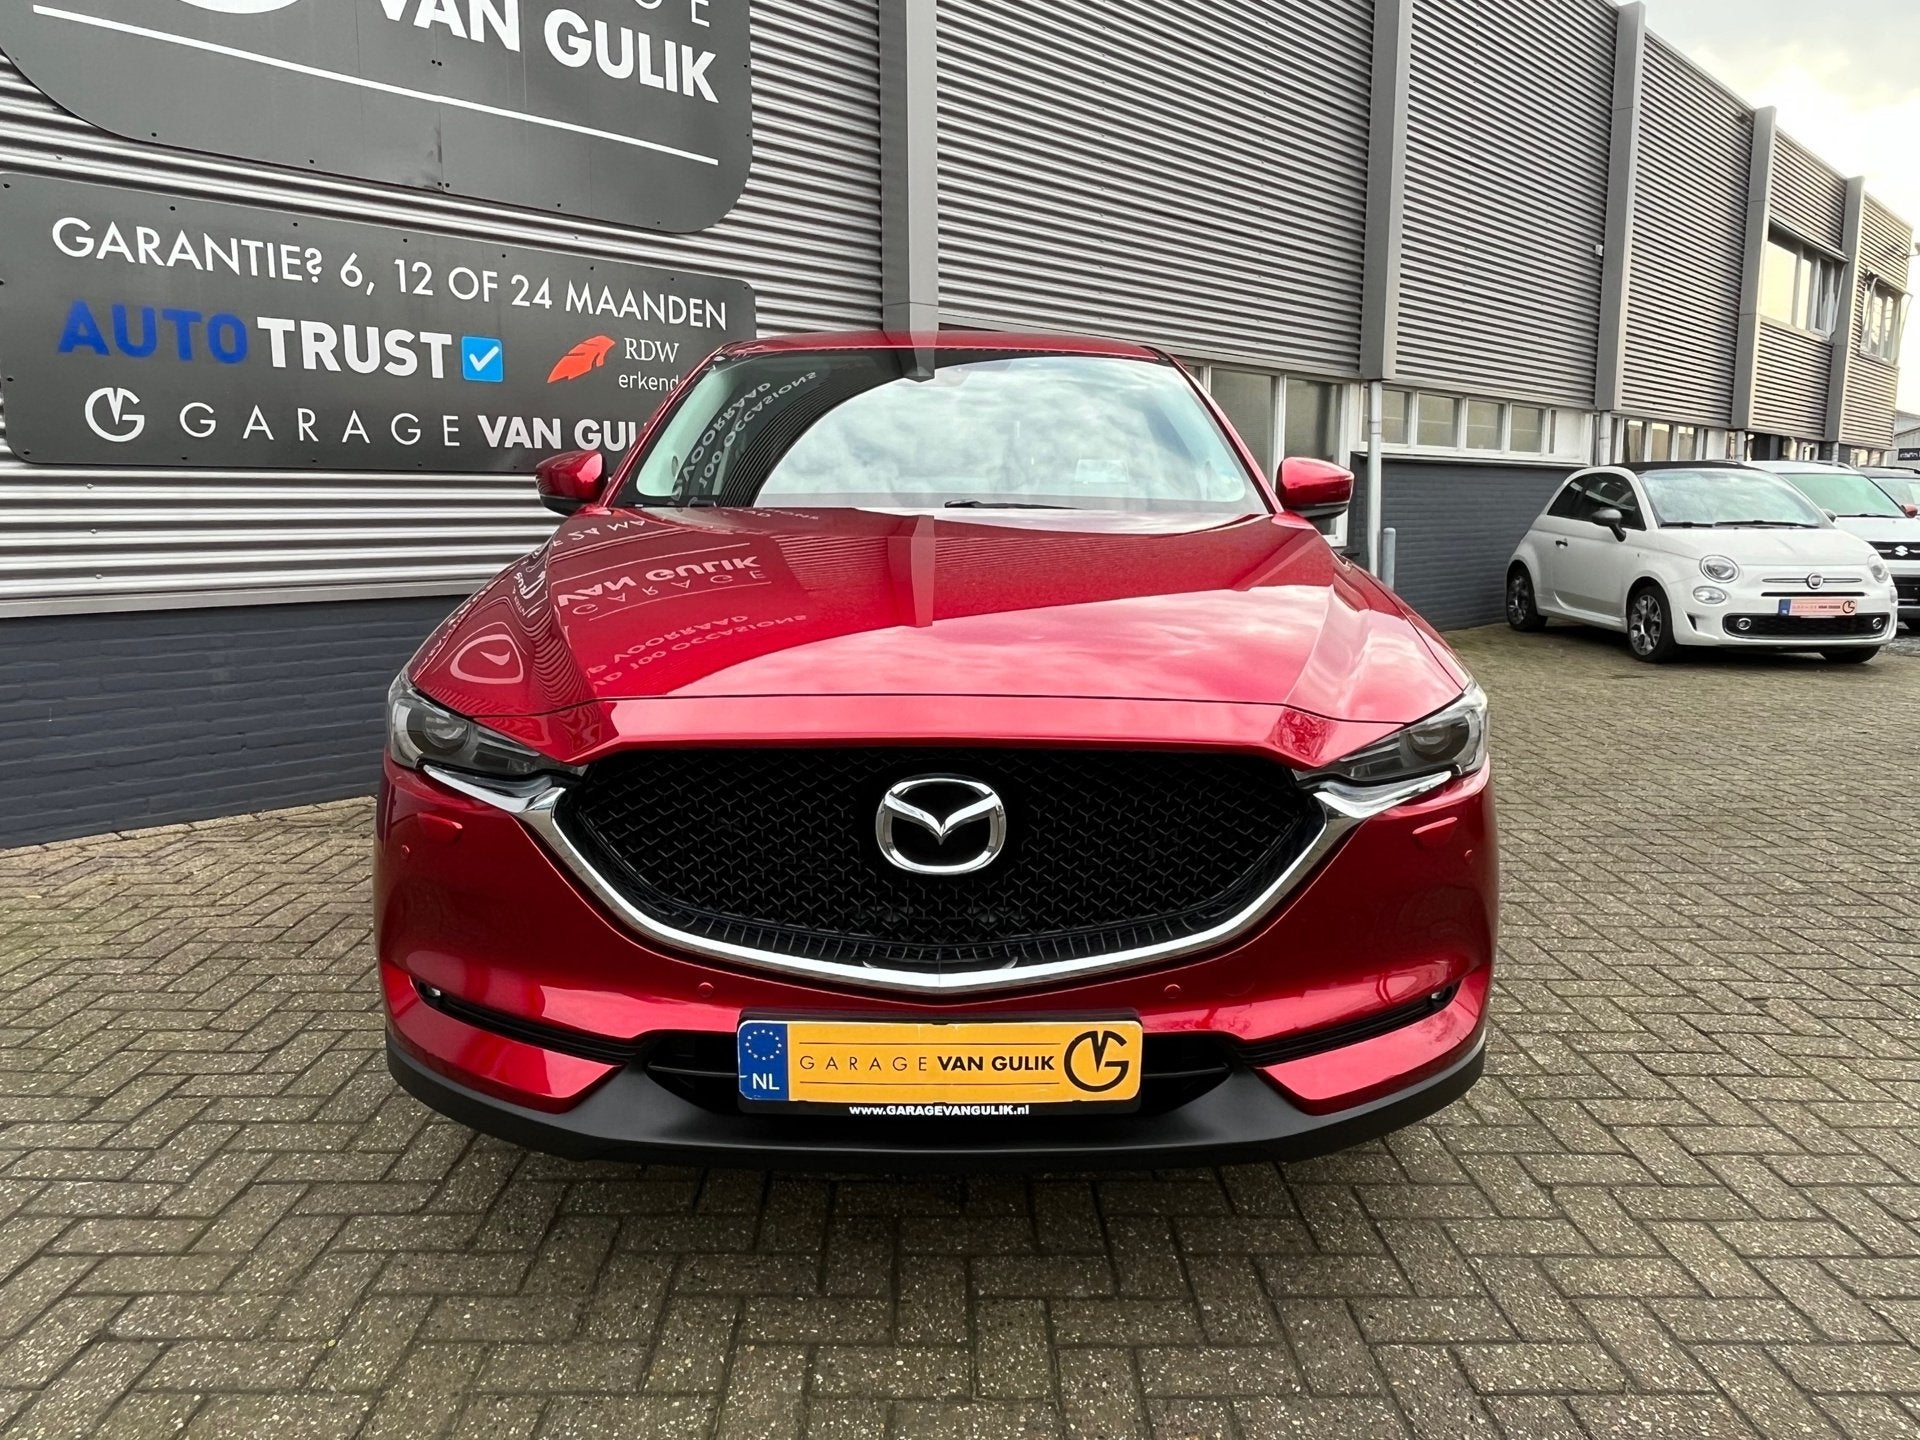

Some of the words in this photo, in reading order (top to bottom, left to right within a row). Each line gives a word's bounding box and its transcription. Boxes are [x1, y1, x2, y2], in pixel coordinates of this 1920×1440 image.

[544, 8, 719, 103] GULIK
[52, 216, 323, 284] GARANTIE?
[340, 252, 375, 296] 6,
[394, 258, 434, 296] 12
[448, 266, 498, 303] OF
[510, 274, 552, 310] 24
[565, 280, 727, 331] MAANDEN
[56, 299, 248, 365] AUTO
[256, 316, 452, 379] TRUST
[624, 337, 680, 363] RDW
[179, 402, 460, 447] GARAGE
[477, 414, 562, 450] VAN
[752, 1072, 780, 1091] NL
[799, 1055, 927, 1072] GARAGE
[937, 1055, 984, 1072] VAN
[991, 1055, 1055, 1072] GULIK
[848, 1104, 1030, 1117] www.GARAGEVANGULIK.nl
